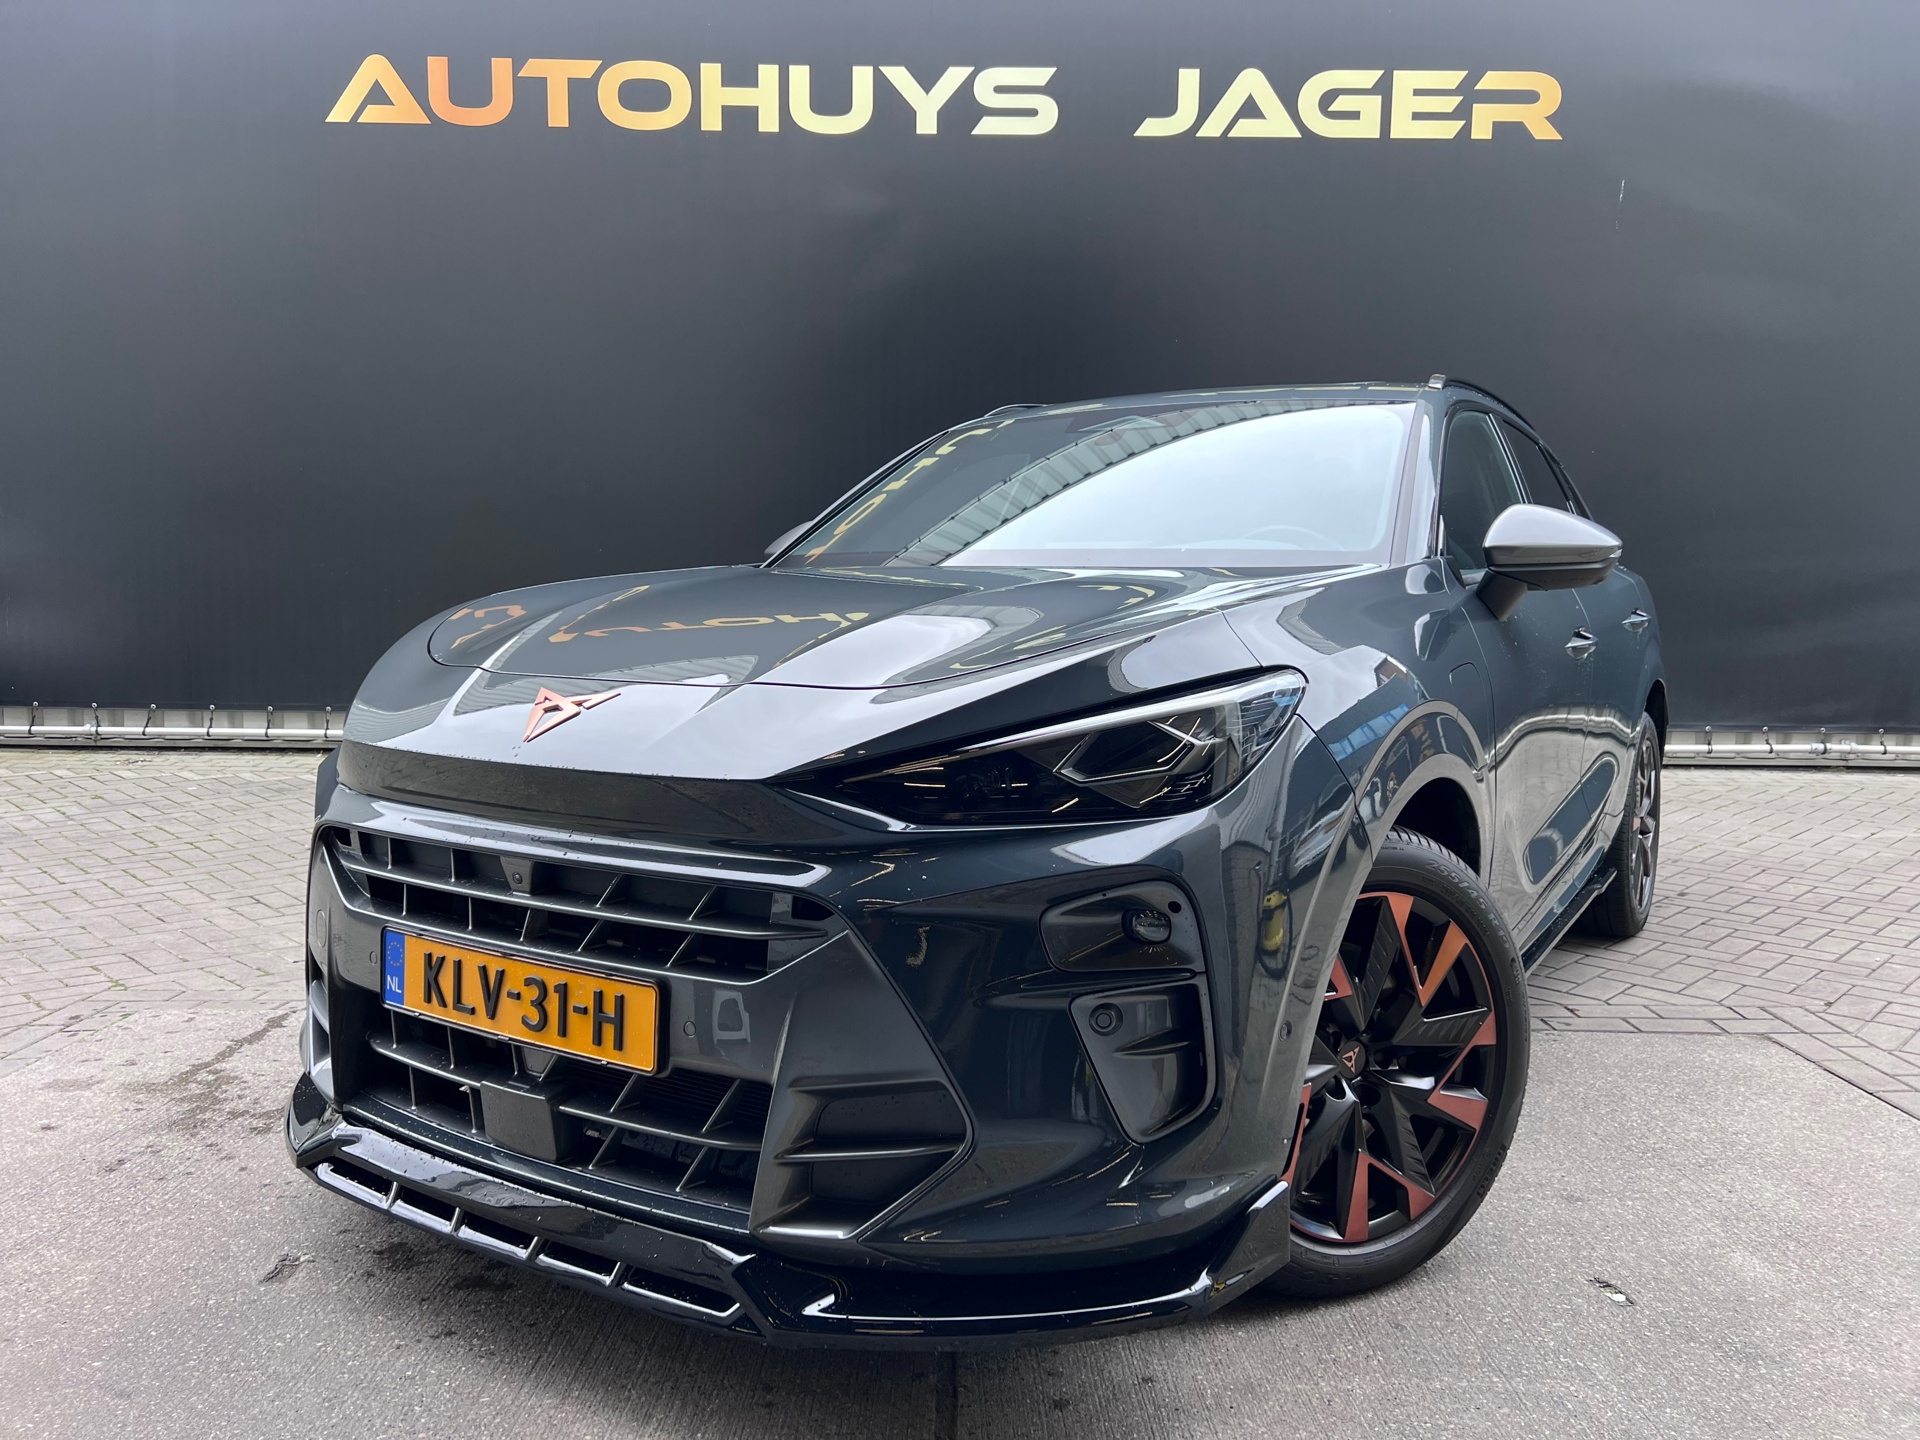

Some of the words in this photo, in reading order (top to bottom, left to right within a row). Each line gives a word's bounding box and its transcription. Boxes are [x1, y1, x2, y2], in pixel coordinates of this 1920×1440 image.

[324, 53, 1059, 136] AUTOHUYS
[1133, 68, 1564, 141] JAGER
[1425, 858, 1488, 910] 255/45
[386, 973, 402, 994] NL
[423, 951, 625, 1052] KLV-31-H
